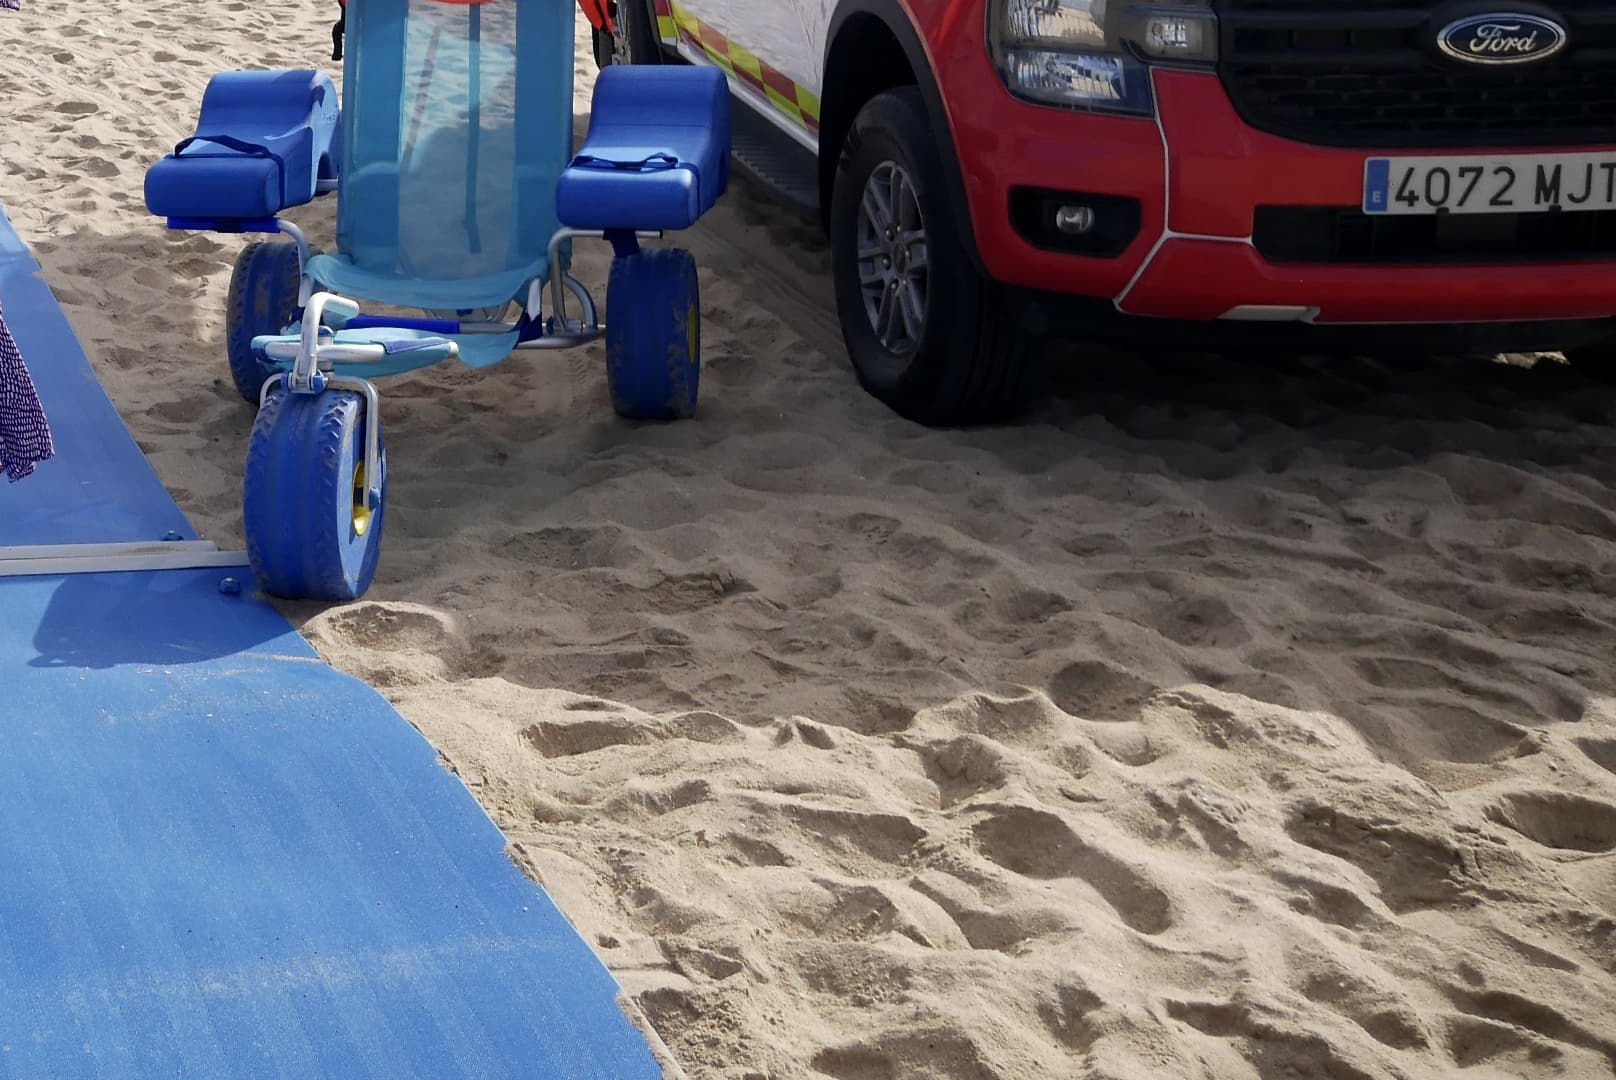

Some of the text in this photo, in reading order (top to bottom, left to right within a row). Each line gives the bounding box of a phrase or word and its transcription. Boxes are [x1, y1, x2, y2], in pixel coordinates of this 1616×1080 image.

[1470, 23, 1537, 53] Ford
[1372, 162, 1616, 208] E 4072 MJT
